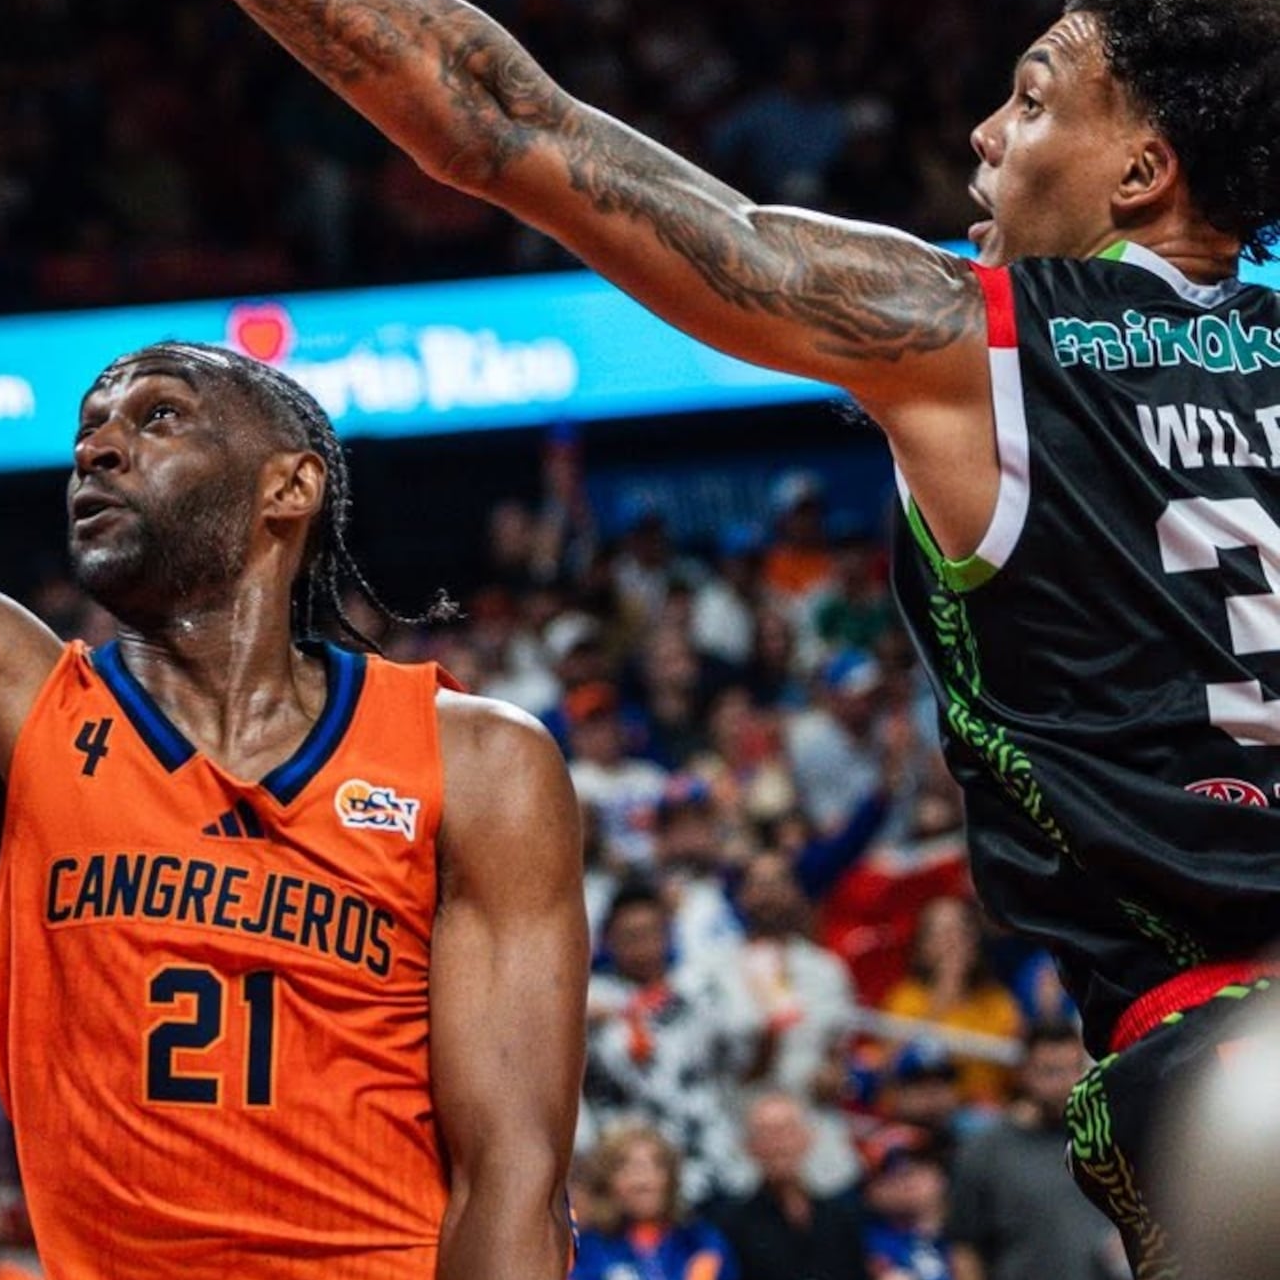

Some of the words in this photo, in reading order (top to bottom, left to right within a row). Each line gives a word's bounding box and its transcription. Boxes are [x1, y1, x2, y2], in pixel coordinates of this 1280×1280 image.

[1048, 309, 1280, 374] mikok
[75, 718, 113, 776] 4
[45, 853, 396, 978] CANGREJEROS
[146, 965, 276, 1107] 21
